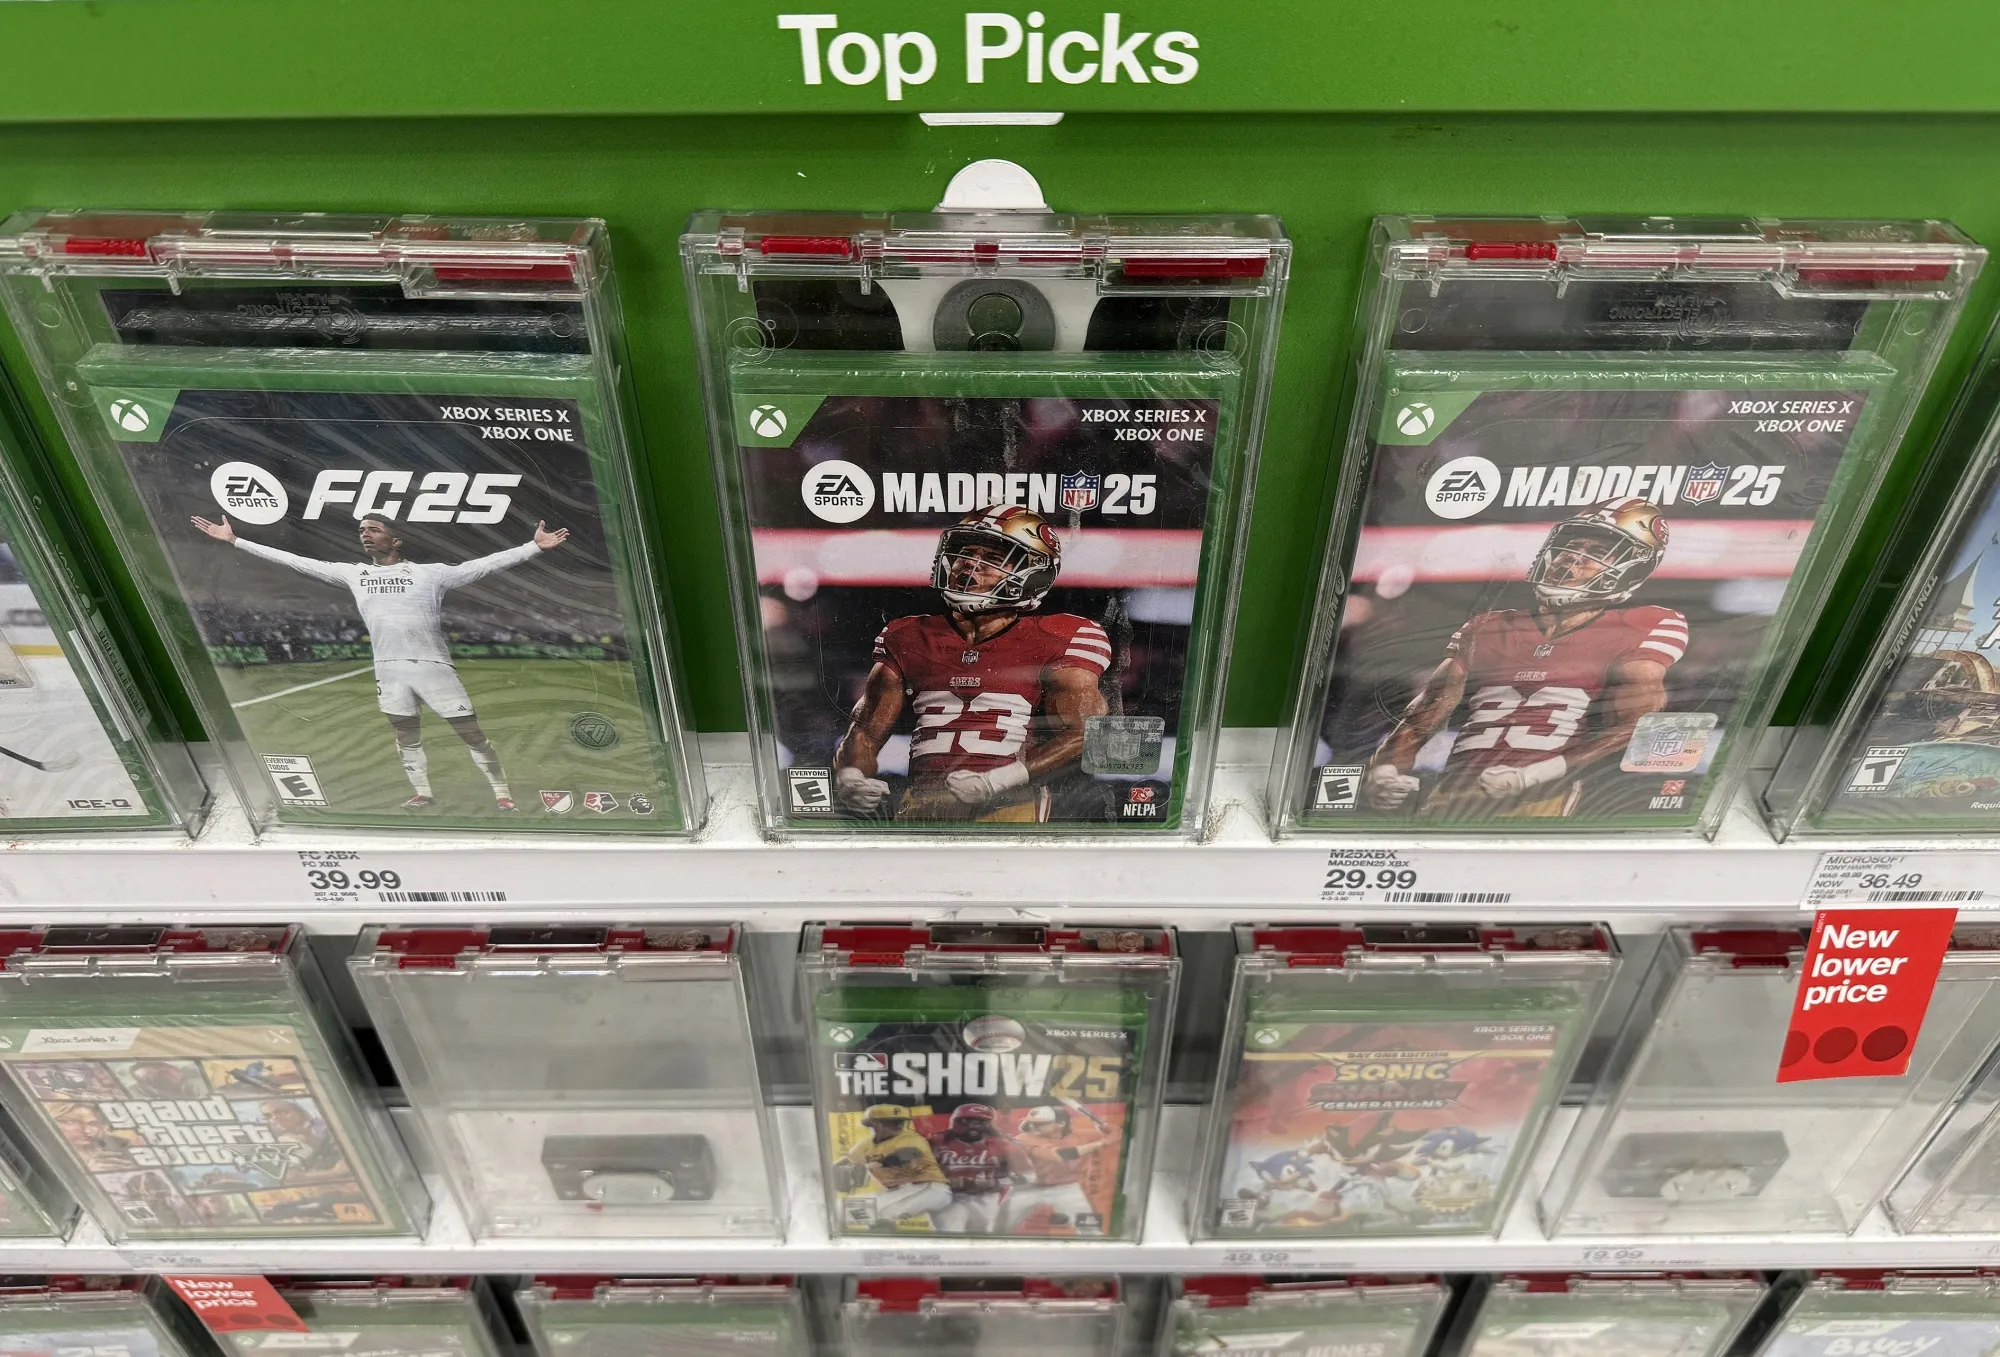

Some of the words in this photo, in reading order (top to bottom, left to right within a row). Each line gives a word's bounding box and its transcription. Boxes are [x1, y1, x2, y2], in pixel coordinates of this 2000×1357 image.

[777, 15, 937, 100] Top
[965, 12, 1199, 85] Picks
[440, 406, 490, 421] XBOX
[495, 407, 553, 423] SERIES
[556, 409, 570, 423] X
[1727, 401, 1780, 413] XBOX
[1780, 401, 1838, 414] SERIES
[1838, 401, 1854, 413] X
[1081, 409, 1131, 422] XBOX
[1134, 409, 1190, 422] SERIES
[1194, 409, 1207, 422] X
[1754, 419, 1806, 432] XBOX
[1807, 419, 1846, 432] ONE
[480, 426, 532, 441] XBOX
[535, 427, 574, 442] ONE
[1114, 428, 1163, 441] XBOX
[1166, 428, 1204, 441] ONE
[225, 476, 274, 497] EA
[815, 474, 860, 495] EA
[1438, 470, 1486, 491] EA
[1503, 465, 1689, 508] MADDEN
[1687, 481, 1719, 500] NFL
[1727, 465, 1786, 507] 25
[882, 472, 1057, 514] MADDEN
[1064, 489, 1095, 508] NFL
[1101, 474, 1157, 515] 25
[1435, 491, 1486, 503] SPORTS
[227, 496, 278, 509] SPORTS
[814, 495, 864, 507] SPORTS
[360, 576, 414, 587] Emirates
[367, 586, 377, 594] FLY
[380, 585, 406, 594] BETTER
[911, 691, 1033, 757] 23
[1453, 686, 1592, 751] 23
[1654, 741, 1680, 755] NFL
[265, 757, 298, 765] EVERYONE
[1864, 759, 1898, 783] T
[280, 775, 315, 797] E
[794, 780, 827, 804] E
[1324, 777, 1352, 802] E
[67, 799, 131, 809] ICE-Q
[1123, 803, 1156, 816] NFLPA
[1648, 796, 1684, 809] NFLPA
[1826, 856, 1907, 864] MICROSOFT
[308, 869, 402, 890] 39.99
[1323, 869, 1417, 889] 29.99
[1814, 880, 1843, 888] NOW
[1858, 873, 1922, 889] 36.49
[1819, 924, 1900, 949] New
[1811, 953, 1908, 978] lower
[1803, 979, 1888, 1011] price
[1045, 1029, 1077, 1037] XBOX
[1080, 1030, 1117, 1038] SERIES
[1472, 1025, 1505, 1033] XBOX
[1507, 1025, 1545, 1033] SERIES
[42, 1036, 73, 1044] Xbox
[74, 1035, 102, 1044] Series
[1526, 1033, 1552, 1041] ONE
[835, 1071, 890, 1095] THE
[892, 1052, 1051, 1097] SHOW
[1050, 1054, 1122, 1099] 25
[1336, 1062, 1450, 1081] SONIC
[1323, 1100, 1444, 1110] GENERATIONS
[175, 1279, 234, 1289] New
[183, 1289, 255, 1300] lower
[194, 1299, 258, 1310] price
